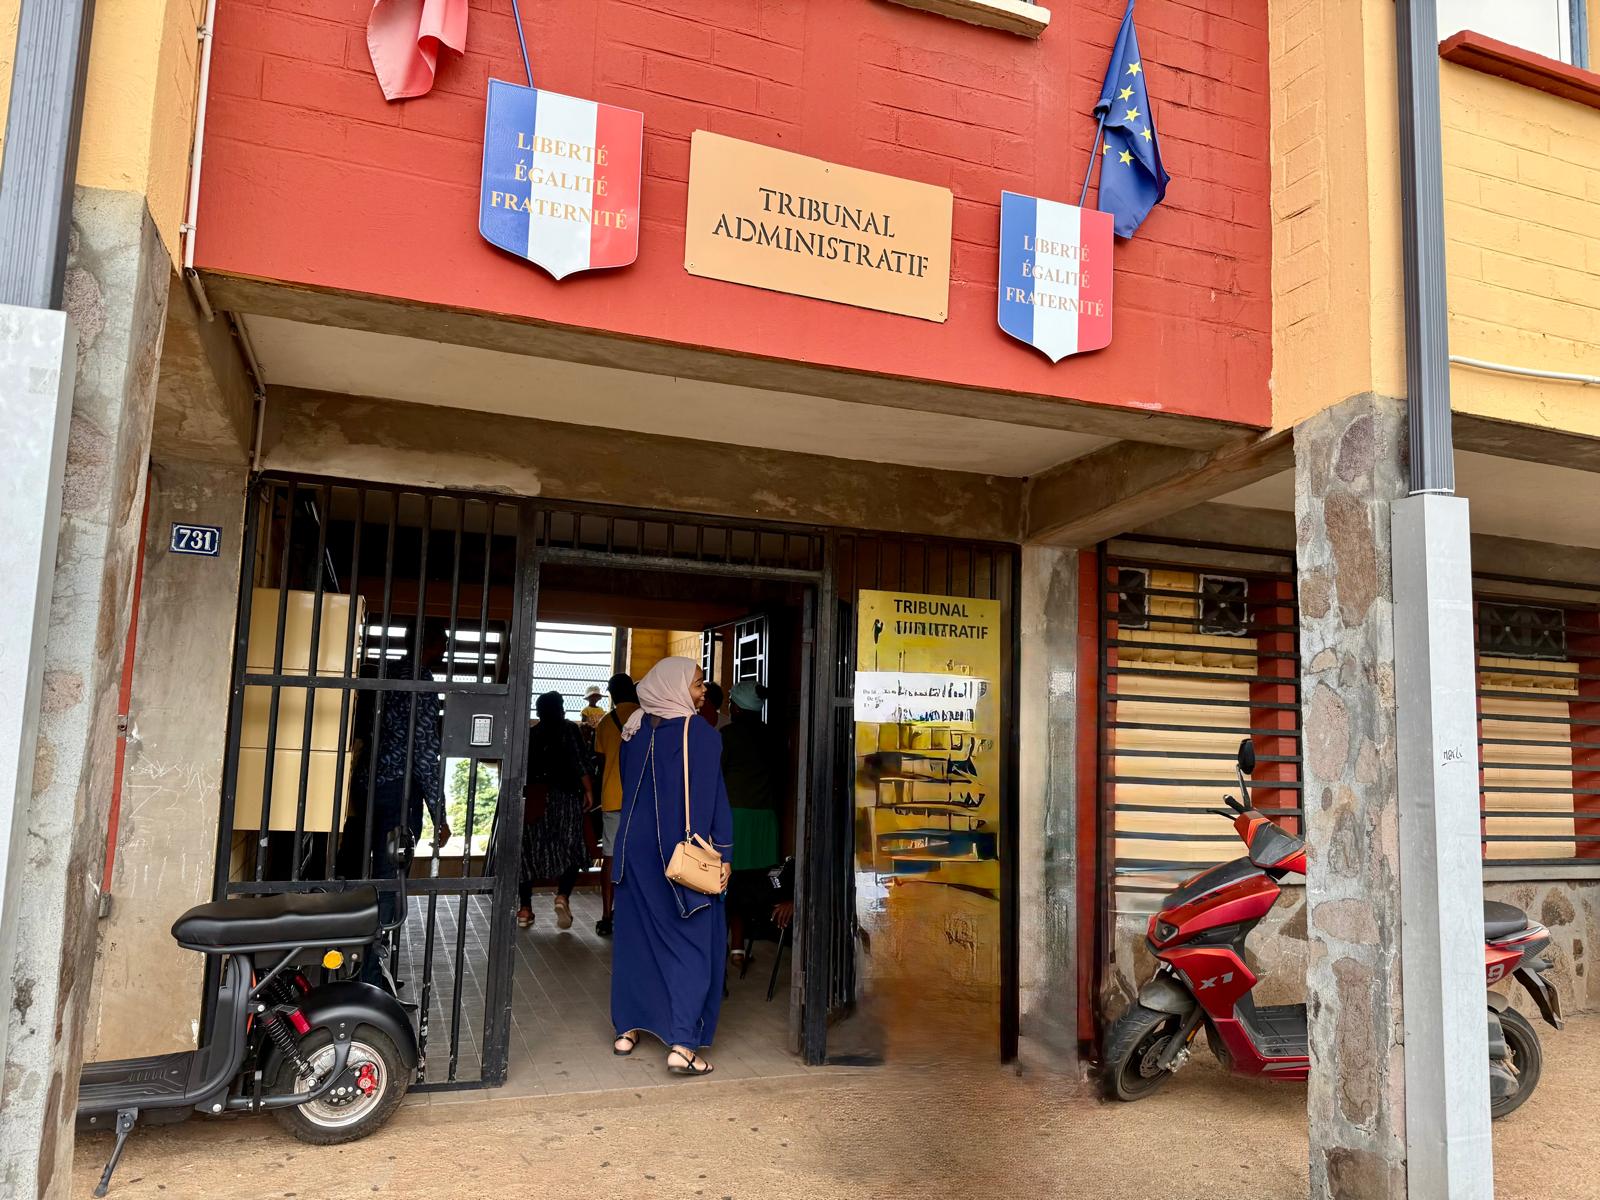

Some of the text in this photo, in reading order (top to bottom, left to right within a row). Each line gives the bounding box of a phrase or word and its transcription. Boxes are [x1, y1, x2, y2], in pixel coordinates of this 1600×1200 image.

[516, 132, 609, 166] LIBERTÉ
[514, 159, 608, 197] ÉGALITÉ
[490, 190, 628, 229] FRATERNITÉ
[758, 187, 895, 238] TRIBUNAL
[711, 213, 929, 278] ADMINISTRATIF
[1023, 235, 1090, 263] LIBERTÉ
[1022, 259, 1090, 288] ÉGALITÉ
[1006, 286, 1104, 318] FRATERNITÉ
[179, 528, 212, 551] 731
[894, 599, 969, 618] TRIBUNAL
[1198, 971, 1234, 990] X1
